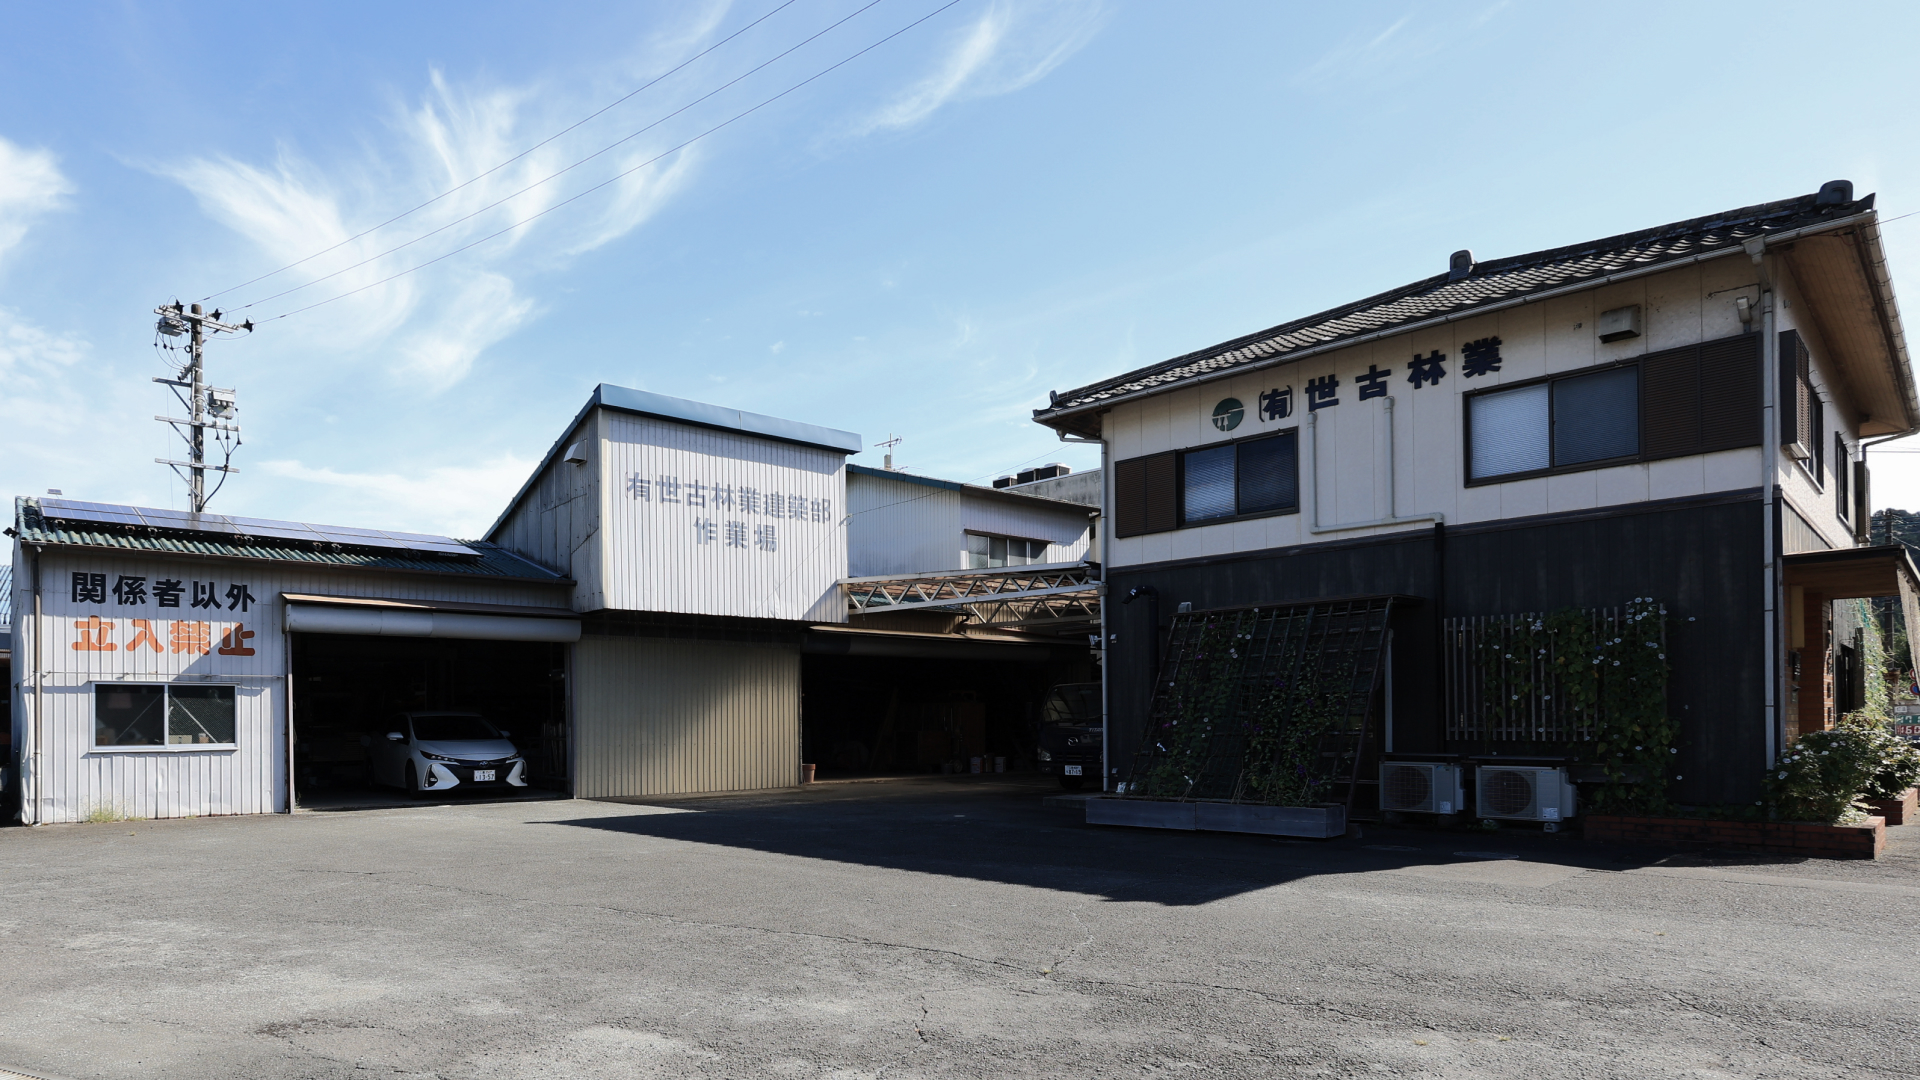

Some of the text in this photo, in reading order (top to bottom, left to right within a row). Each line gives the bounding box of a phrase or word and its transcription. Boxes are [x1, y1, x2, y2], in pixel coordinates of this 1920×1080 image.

[693, 516, 777, 552] 作業場
[72, 572, 256, 612] 関係者以外
[72, 615, 256, 656] 立入禁止
